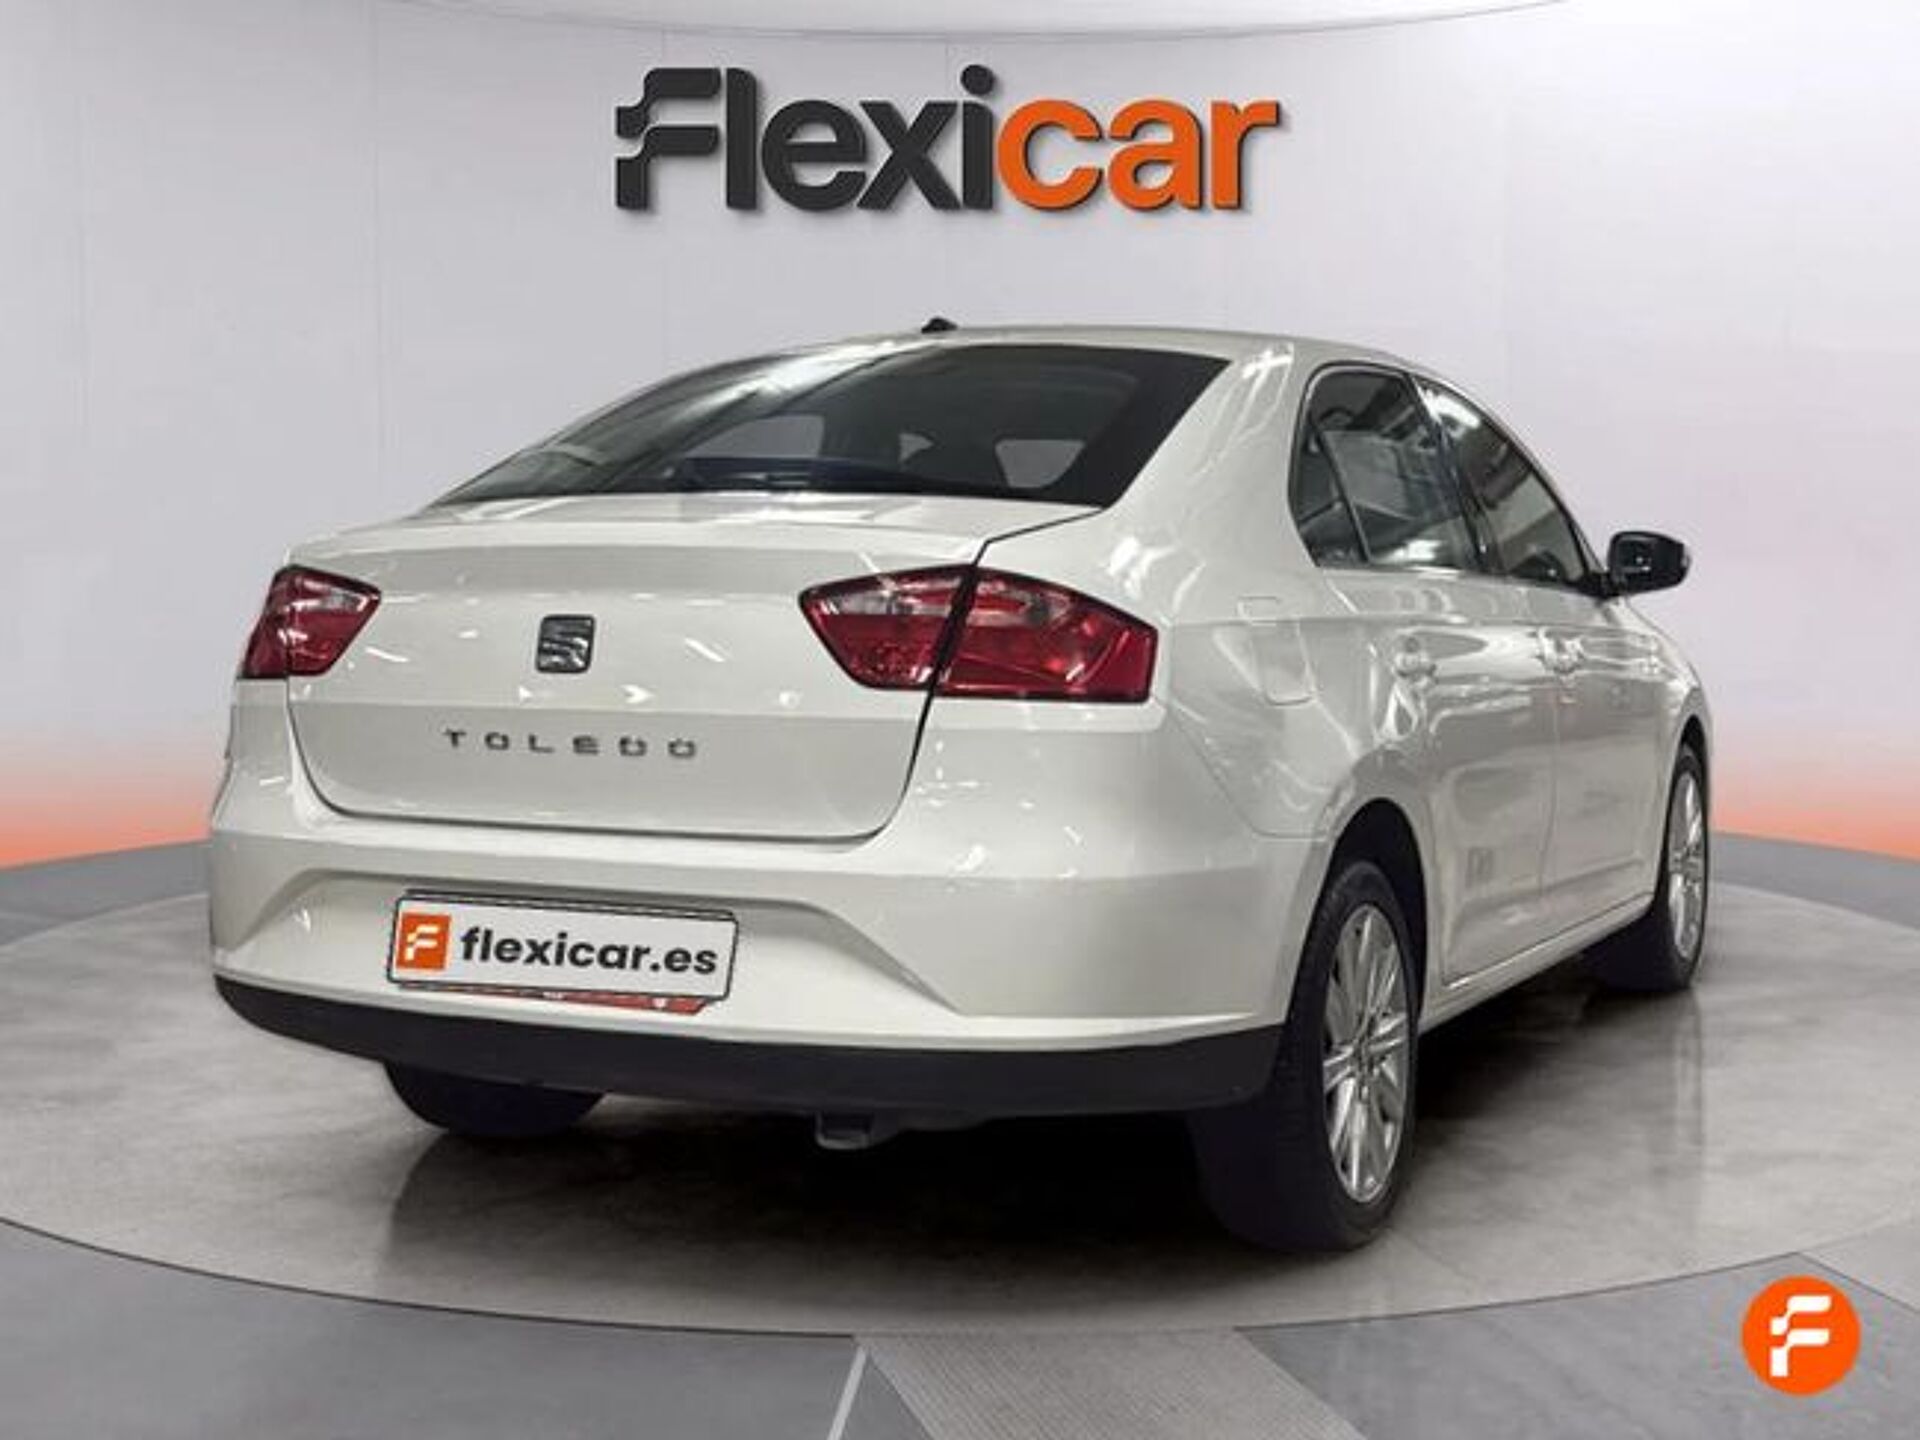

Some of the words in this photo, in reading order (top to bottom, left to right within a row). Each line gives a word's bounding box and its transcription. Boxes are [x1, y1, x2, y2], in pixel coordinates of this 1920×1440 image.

[615, 65, 1279, 210] Flexicar
[444, 728, 697, 759] TOLEDO
[459, 926, 718, 975] flexicar.es
